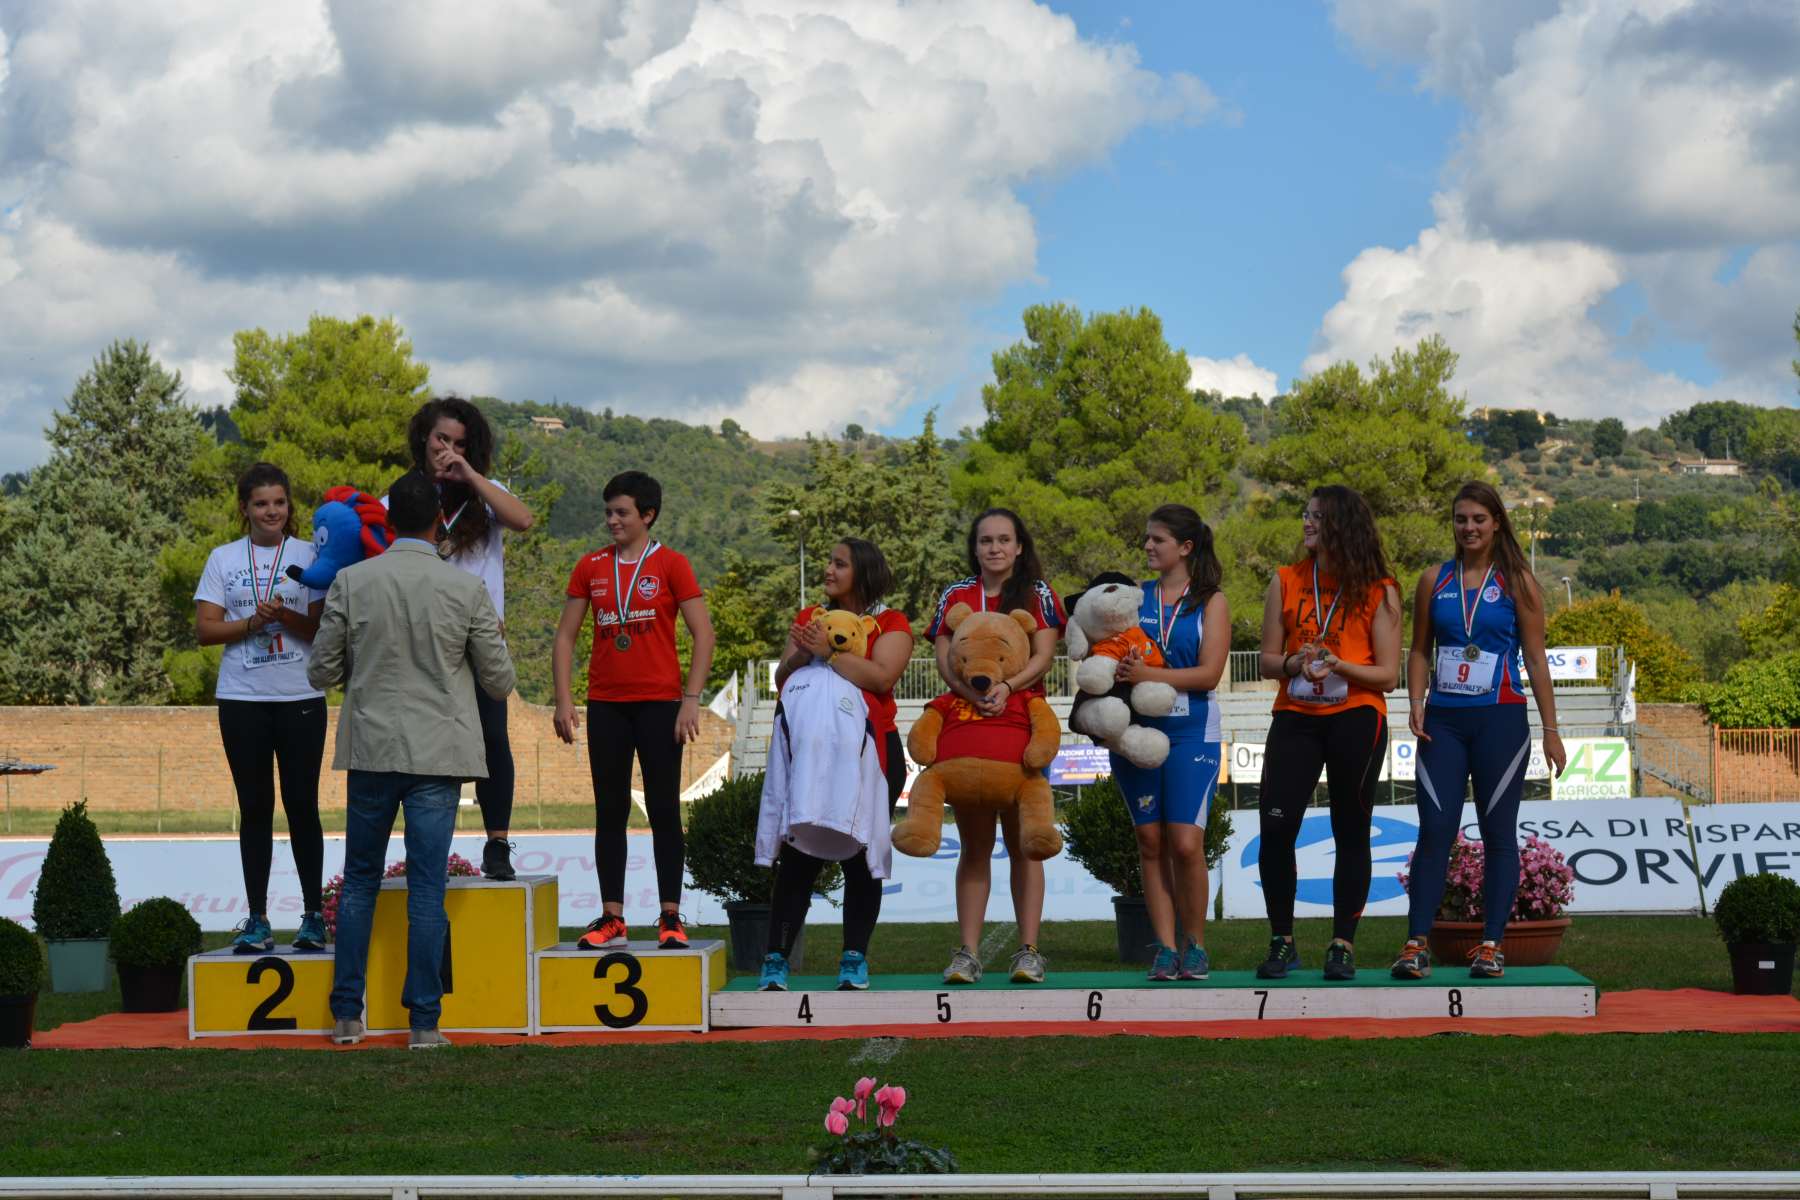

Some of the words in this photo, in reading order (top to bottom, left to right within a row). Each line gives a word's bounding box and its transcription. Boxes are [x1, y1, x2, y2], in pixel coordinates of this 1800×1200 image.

[1457, 663, 1471, 683] 9
[1558, 743, 1627, 782] AZ
[1557, 784, 1627, 796] AGRICOLA
[1462, 819, 1594, 841] CSSA
[1608, 818, 1649, 837] DI
[247, 957, 297, 1030] 2
[593, 952, 648, 1029] 3
[1448, 989, 1463, 1018] 8
[797, 994, 813, 1023] 4
[936, 993, 951, 1022] 5
[1087, 991, 1103, 1021] 6
[1254, 991, 1268, 1020] 7
